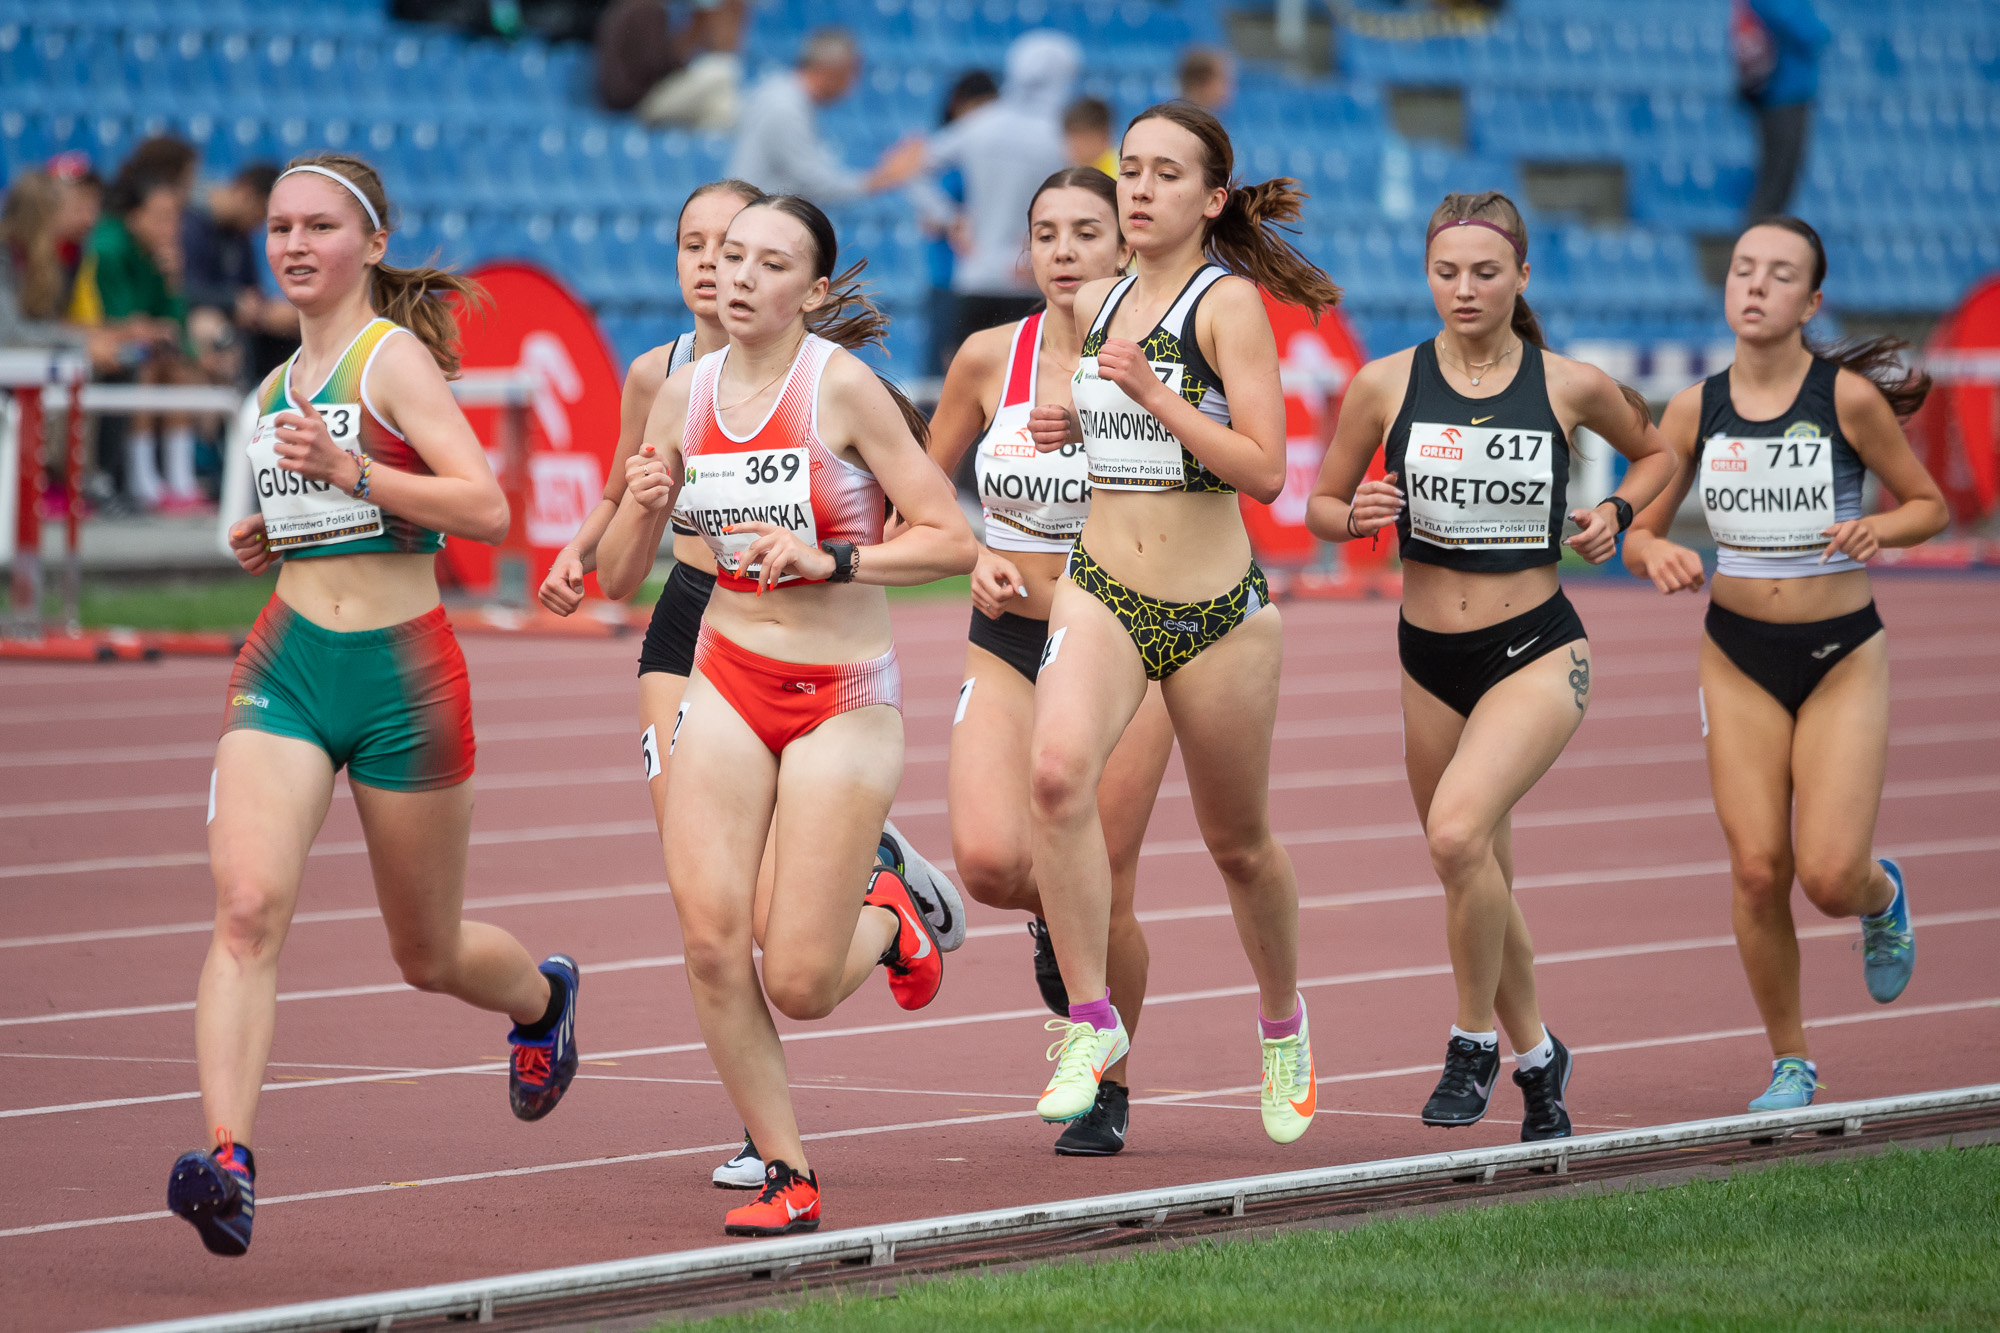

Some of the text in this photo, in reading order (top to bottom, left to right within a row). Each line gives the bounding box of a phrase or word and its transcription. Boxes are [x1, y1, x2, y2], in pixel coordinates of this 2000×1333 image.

[995, 445, 1035, 457] ORLEN
[1421, 446, 1462, 459] ORLEN
[1486, 433, 1543, 461] 617
[1765, 442, 1822, 469] 717
[745, 453, 800, 485] 369
[1094, 463, 1137, 473] Mistrzostwa
[1140, 466, 1163, 475] Polski
[1165, 467, 1181, 476] U18
[1411, 473, 1546, 509] KRĘTOSZ
[1705, 485, 1828, 513] BOCHNIAK
[280, 520, 323, 532] Mistrzostwa
[326, 514, 355, 526] Polski
[357, 509, 377, 521] U18
[1025, 515, 1073, 530] Mistrzostwa
[1424, 521, 1442, 532] PZLA
[1444, 525, 1497, 534] Mistrzostwa
[1499, 524, 1526, 533] Polski
[1528, 524, 1546, 532] U18
